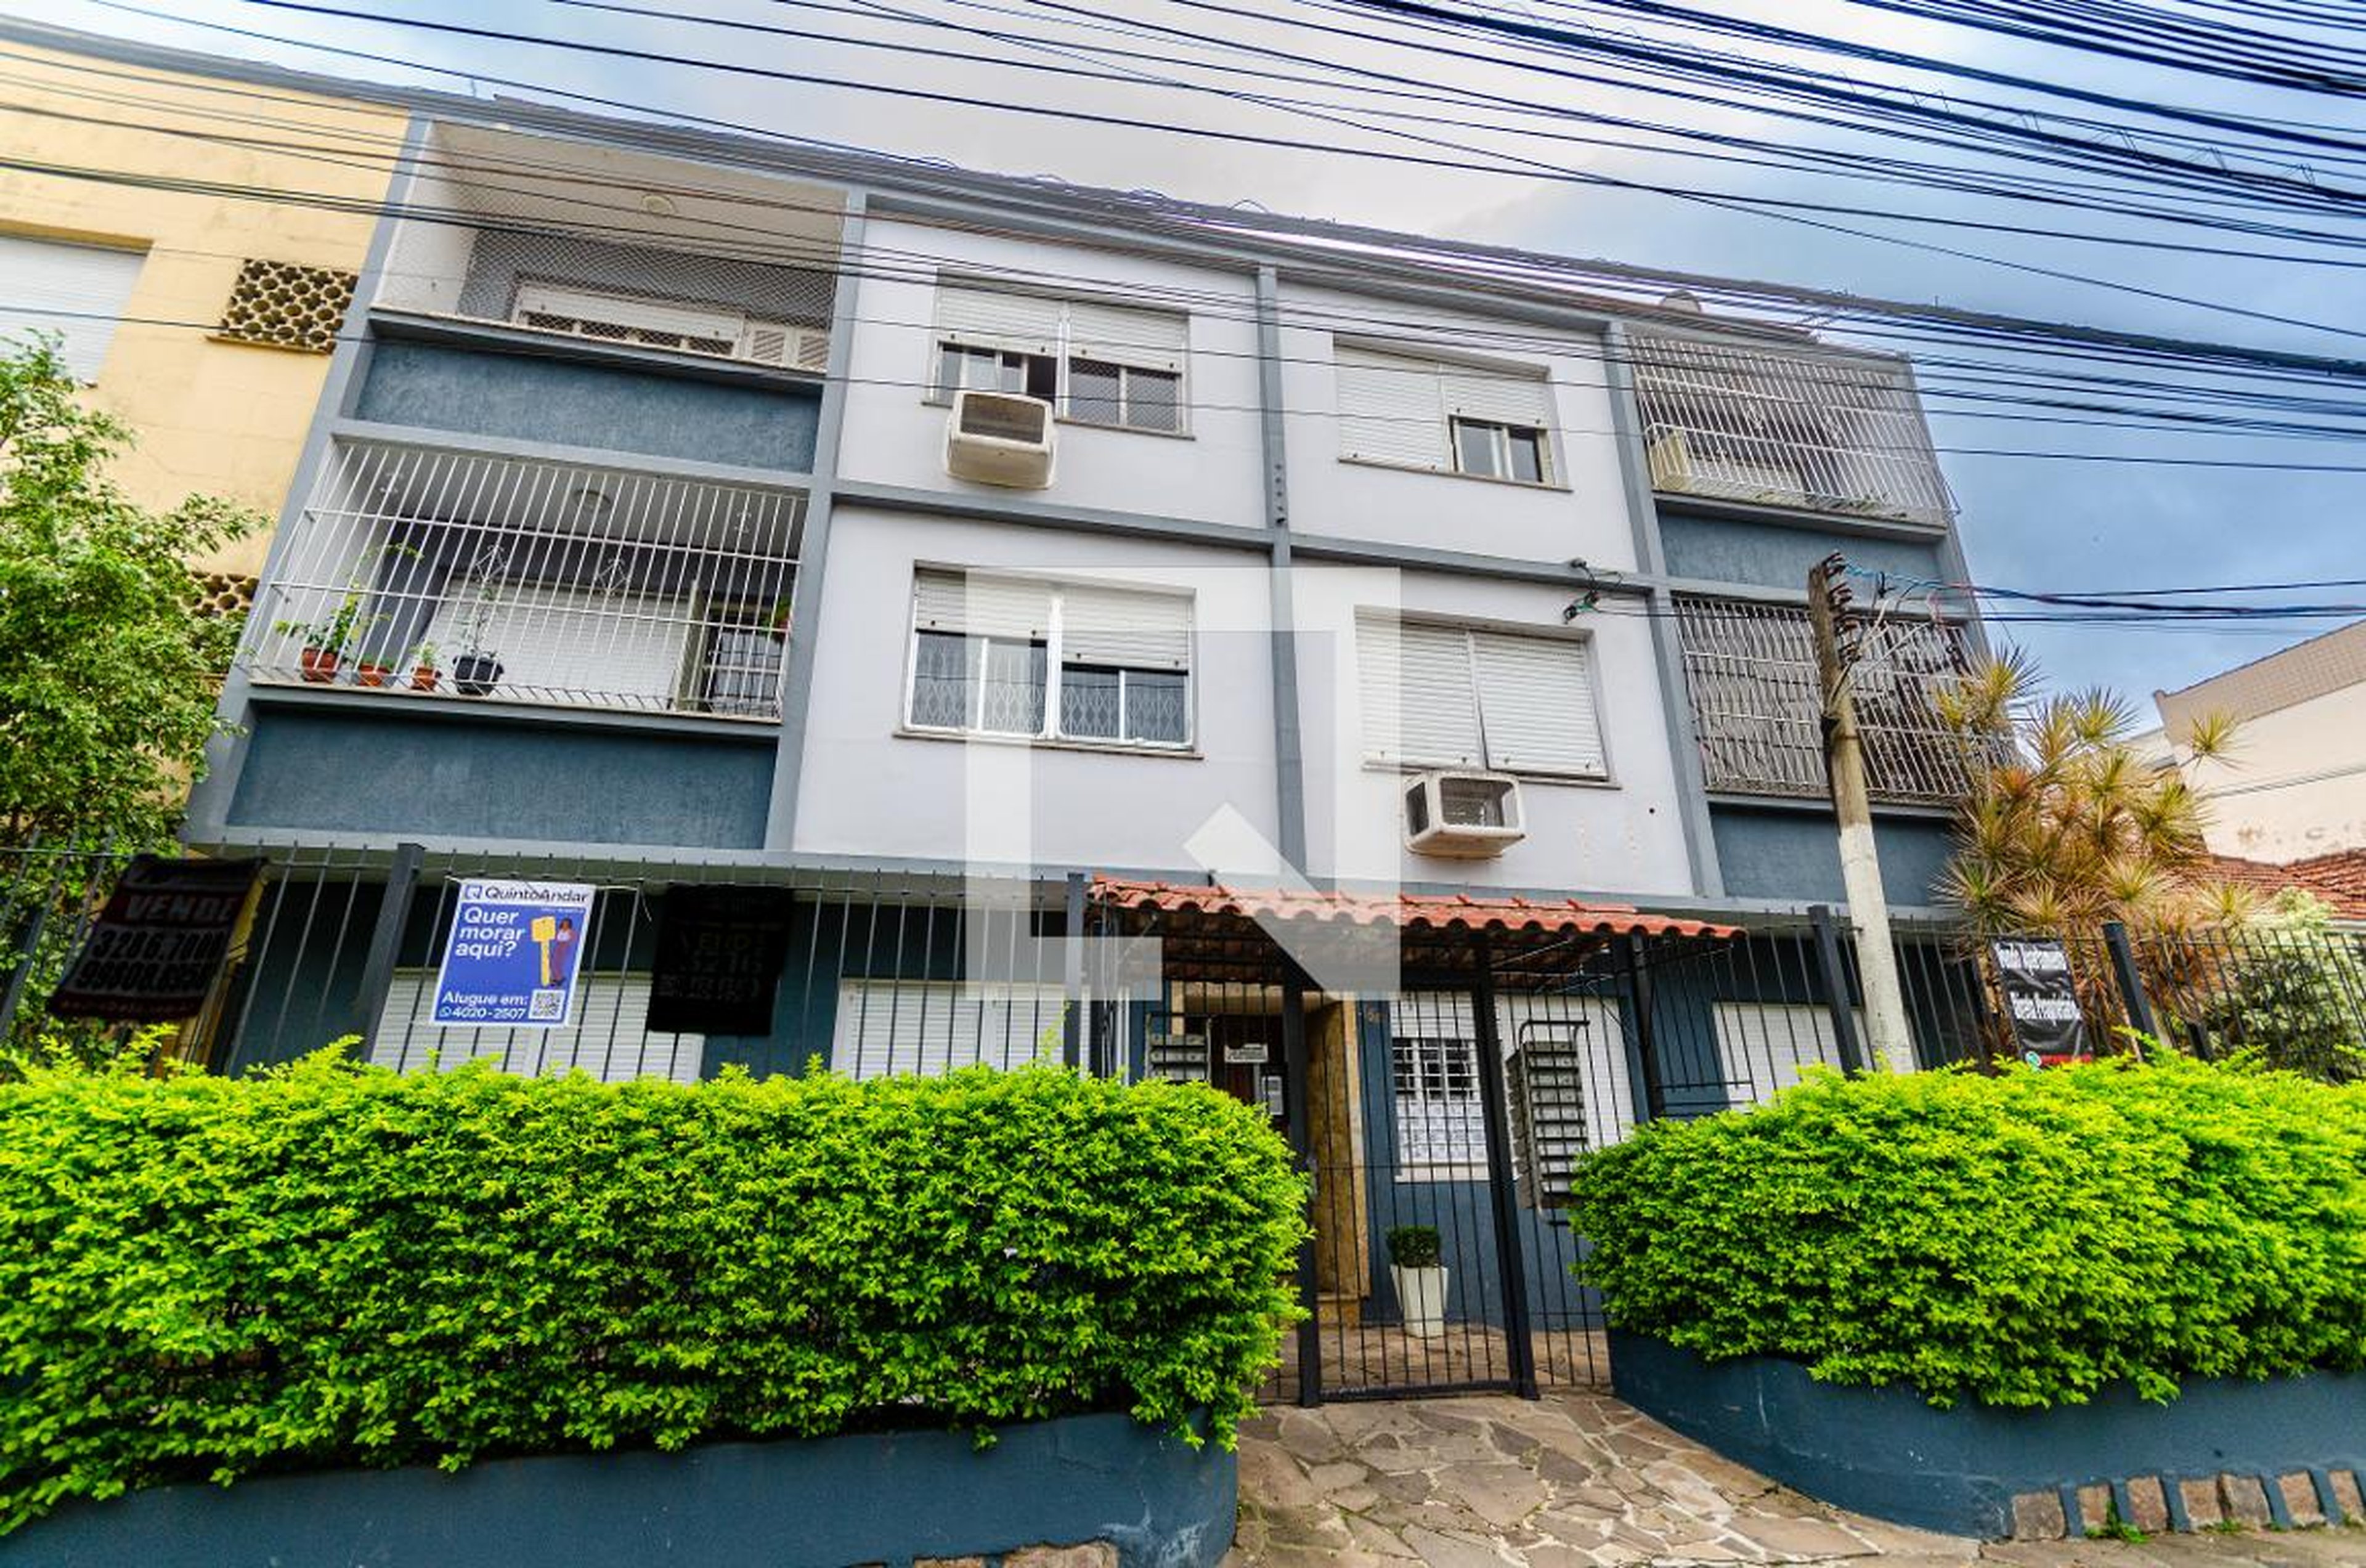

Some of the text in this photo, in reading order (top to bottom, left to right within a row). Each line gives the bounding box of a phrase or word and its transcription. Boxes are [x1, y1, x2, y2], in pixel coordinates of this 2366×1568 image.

[486, 885, 588, 903] QuintoAndar
[464, 906, 519, 924] Quer
[460, 925, 525, 941] morar
[455, 941, 516, 959] aqui?
[442, 991, 529, 1006] Alugue em:
